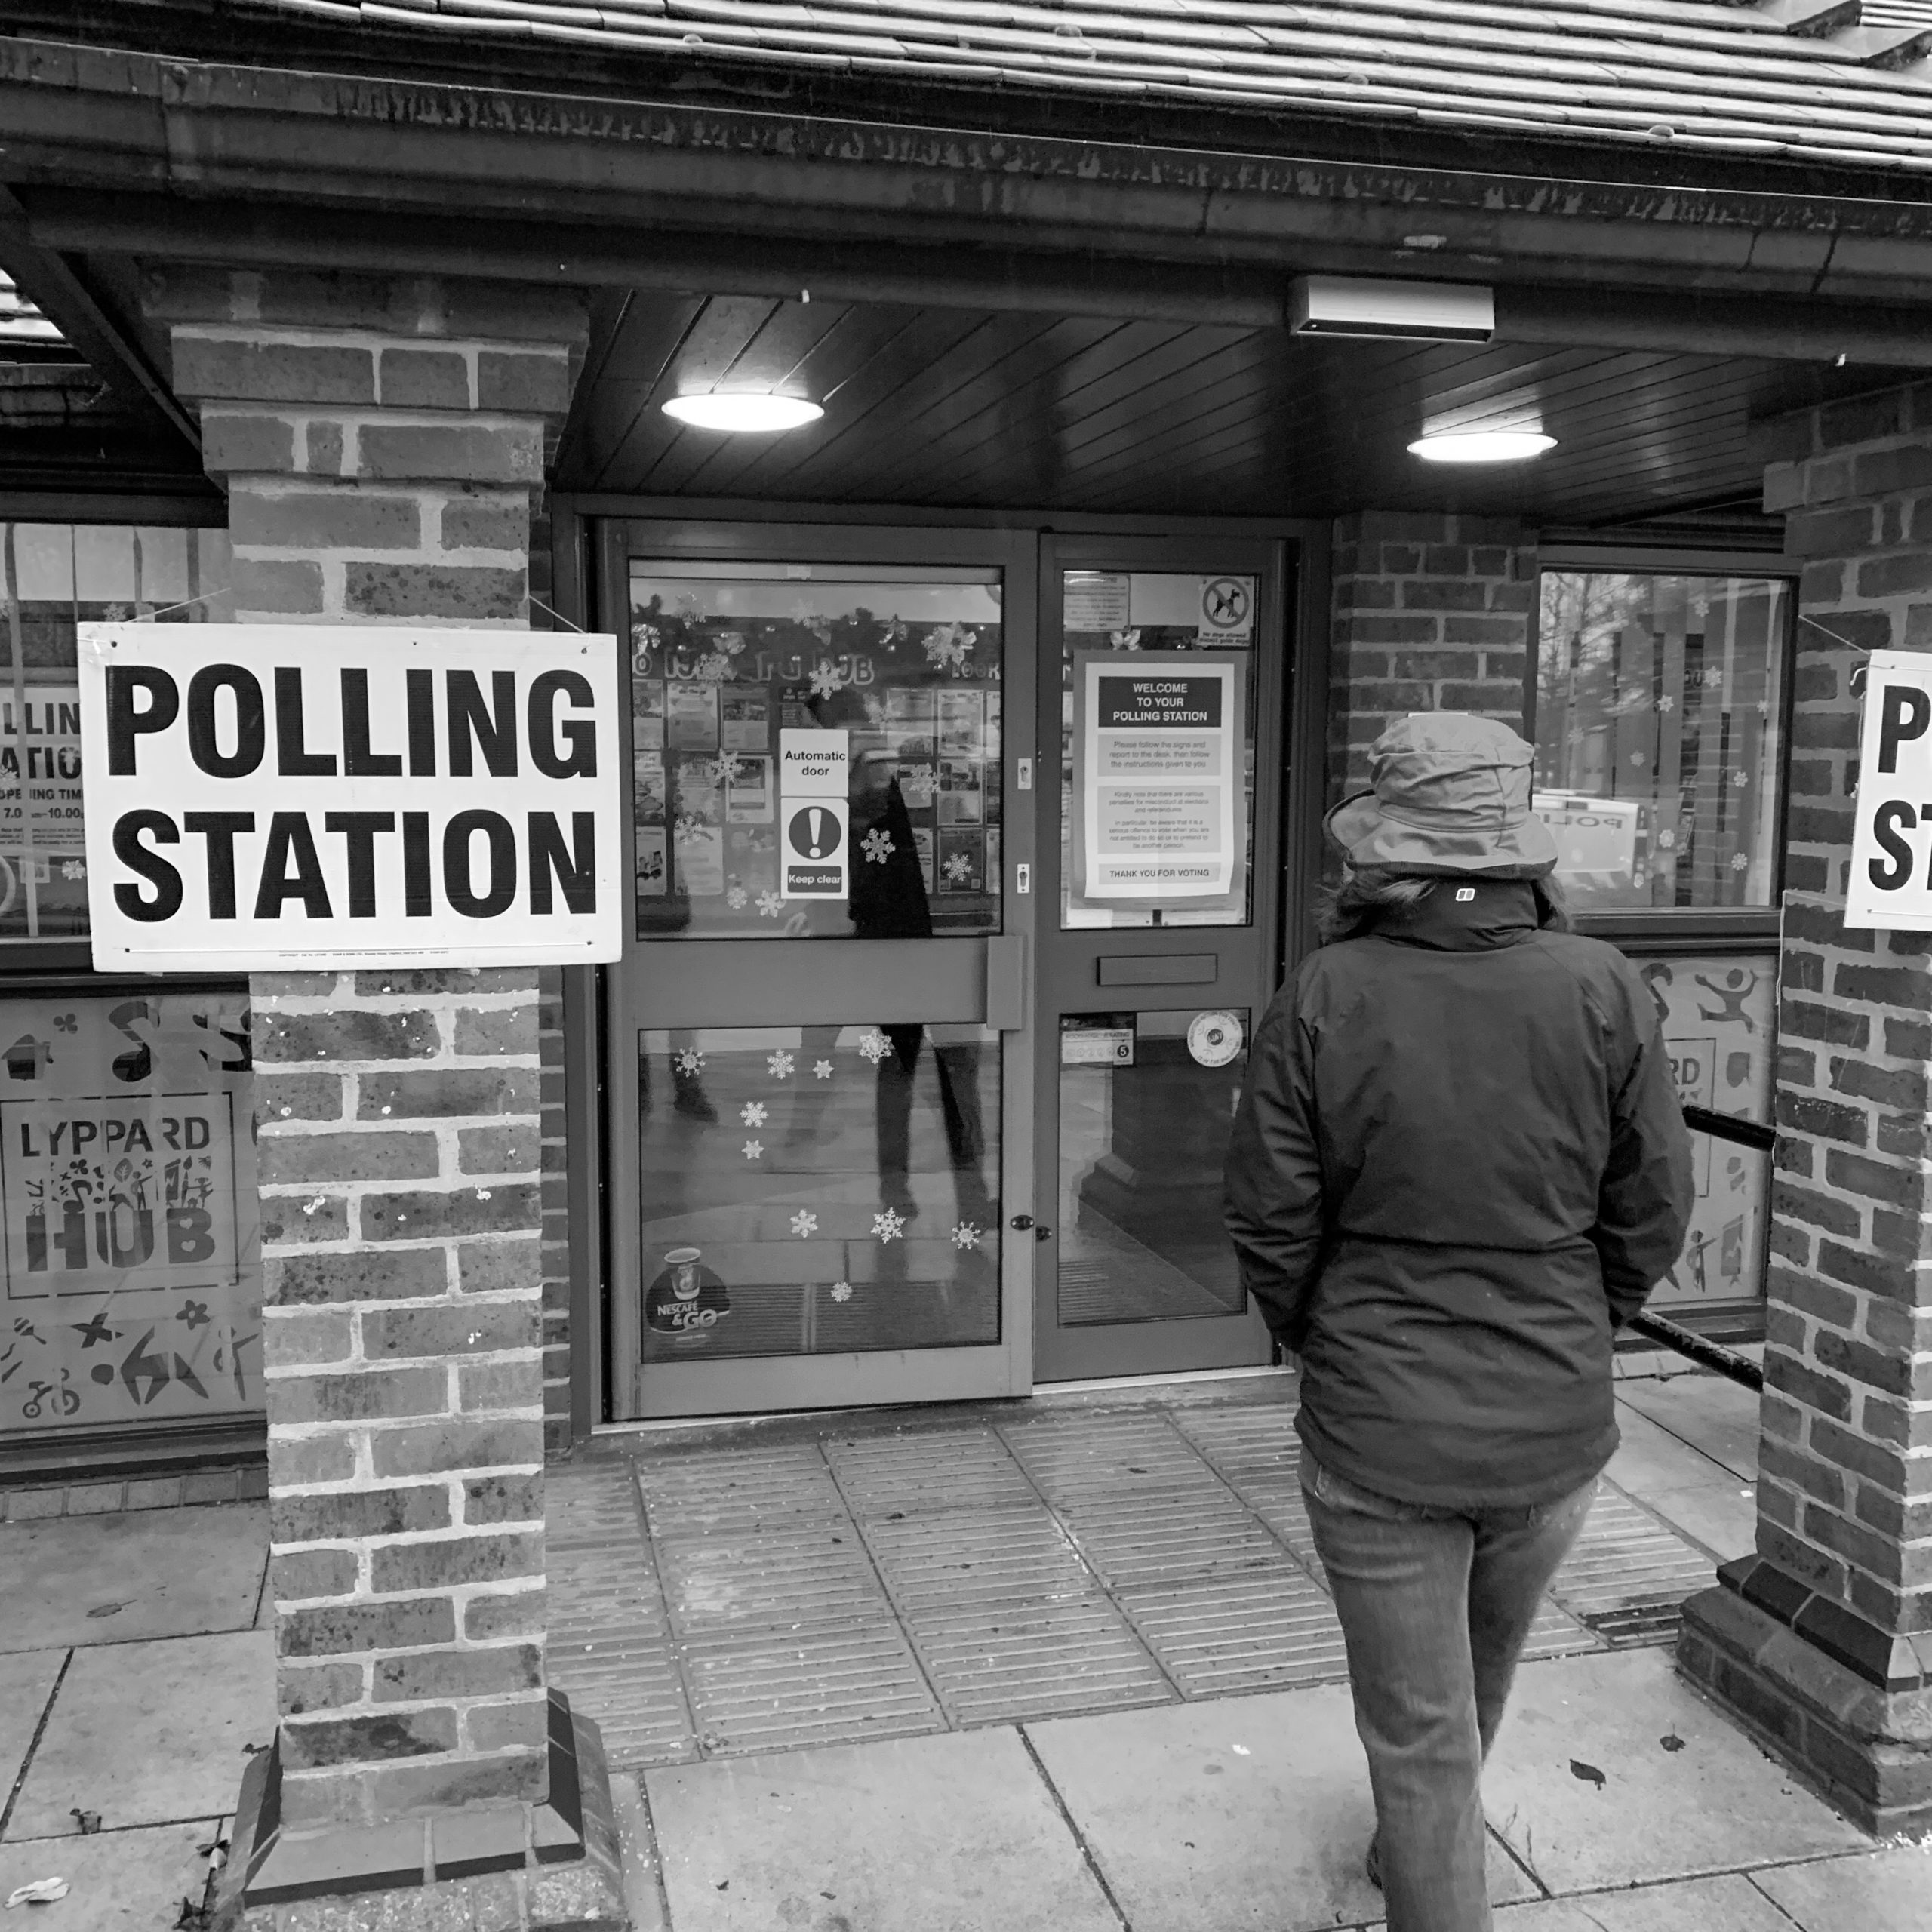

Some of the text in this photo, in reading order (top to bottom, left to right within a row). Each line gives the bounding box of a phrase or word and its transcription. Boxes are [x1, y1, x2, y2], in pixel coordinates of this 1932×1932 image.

[1133, 683, 1188, 693] WELCOME
[1137, 697, 1183, 707] TO YOUR
[105, 663, 597, 779] POLLING
[1113, 711, 1208, 721] POLLING STATION
[785, 749, 845, 761] Automatic
[801, 765, 829, 776] door
[58, 789, 83, 800] TIM
[1868, 800, 1932, 891] S
[113, 808, 597, 922] STATION
[1109, 869, 1137, 878] THANK
[1177, 869, 1209, 877] VOTING
[788, 874, 841, 885] Keep clear
[20, 1116, 210, 1157] LYPPARD
[26, 1208, 216, 1272] HUB
